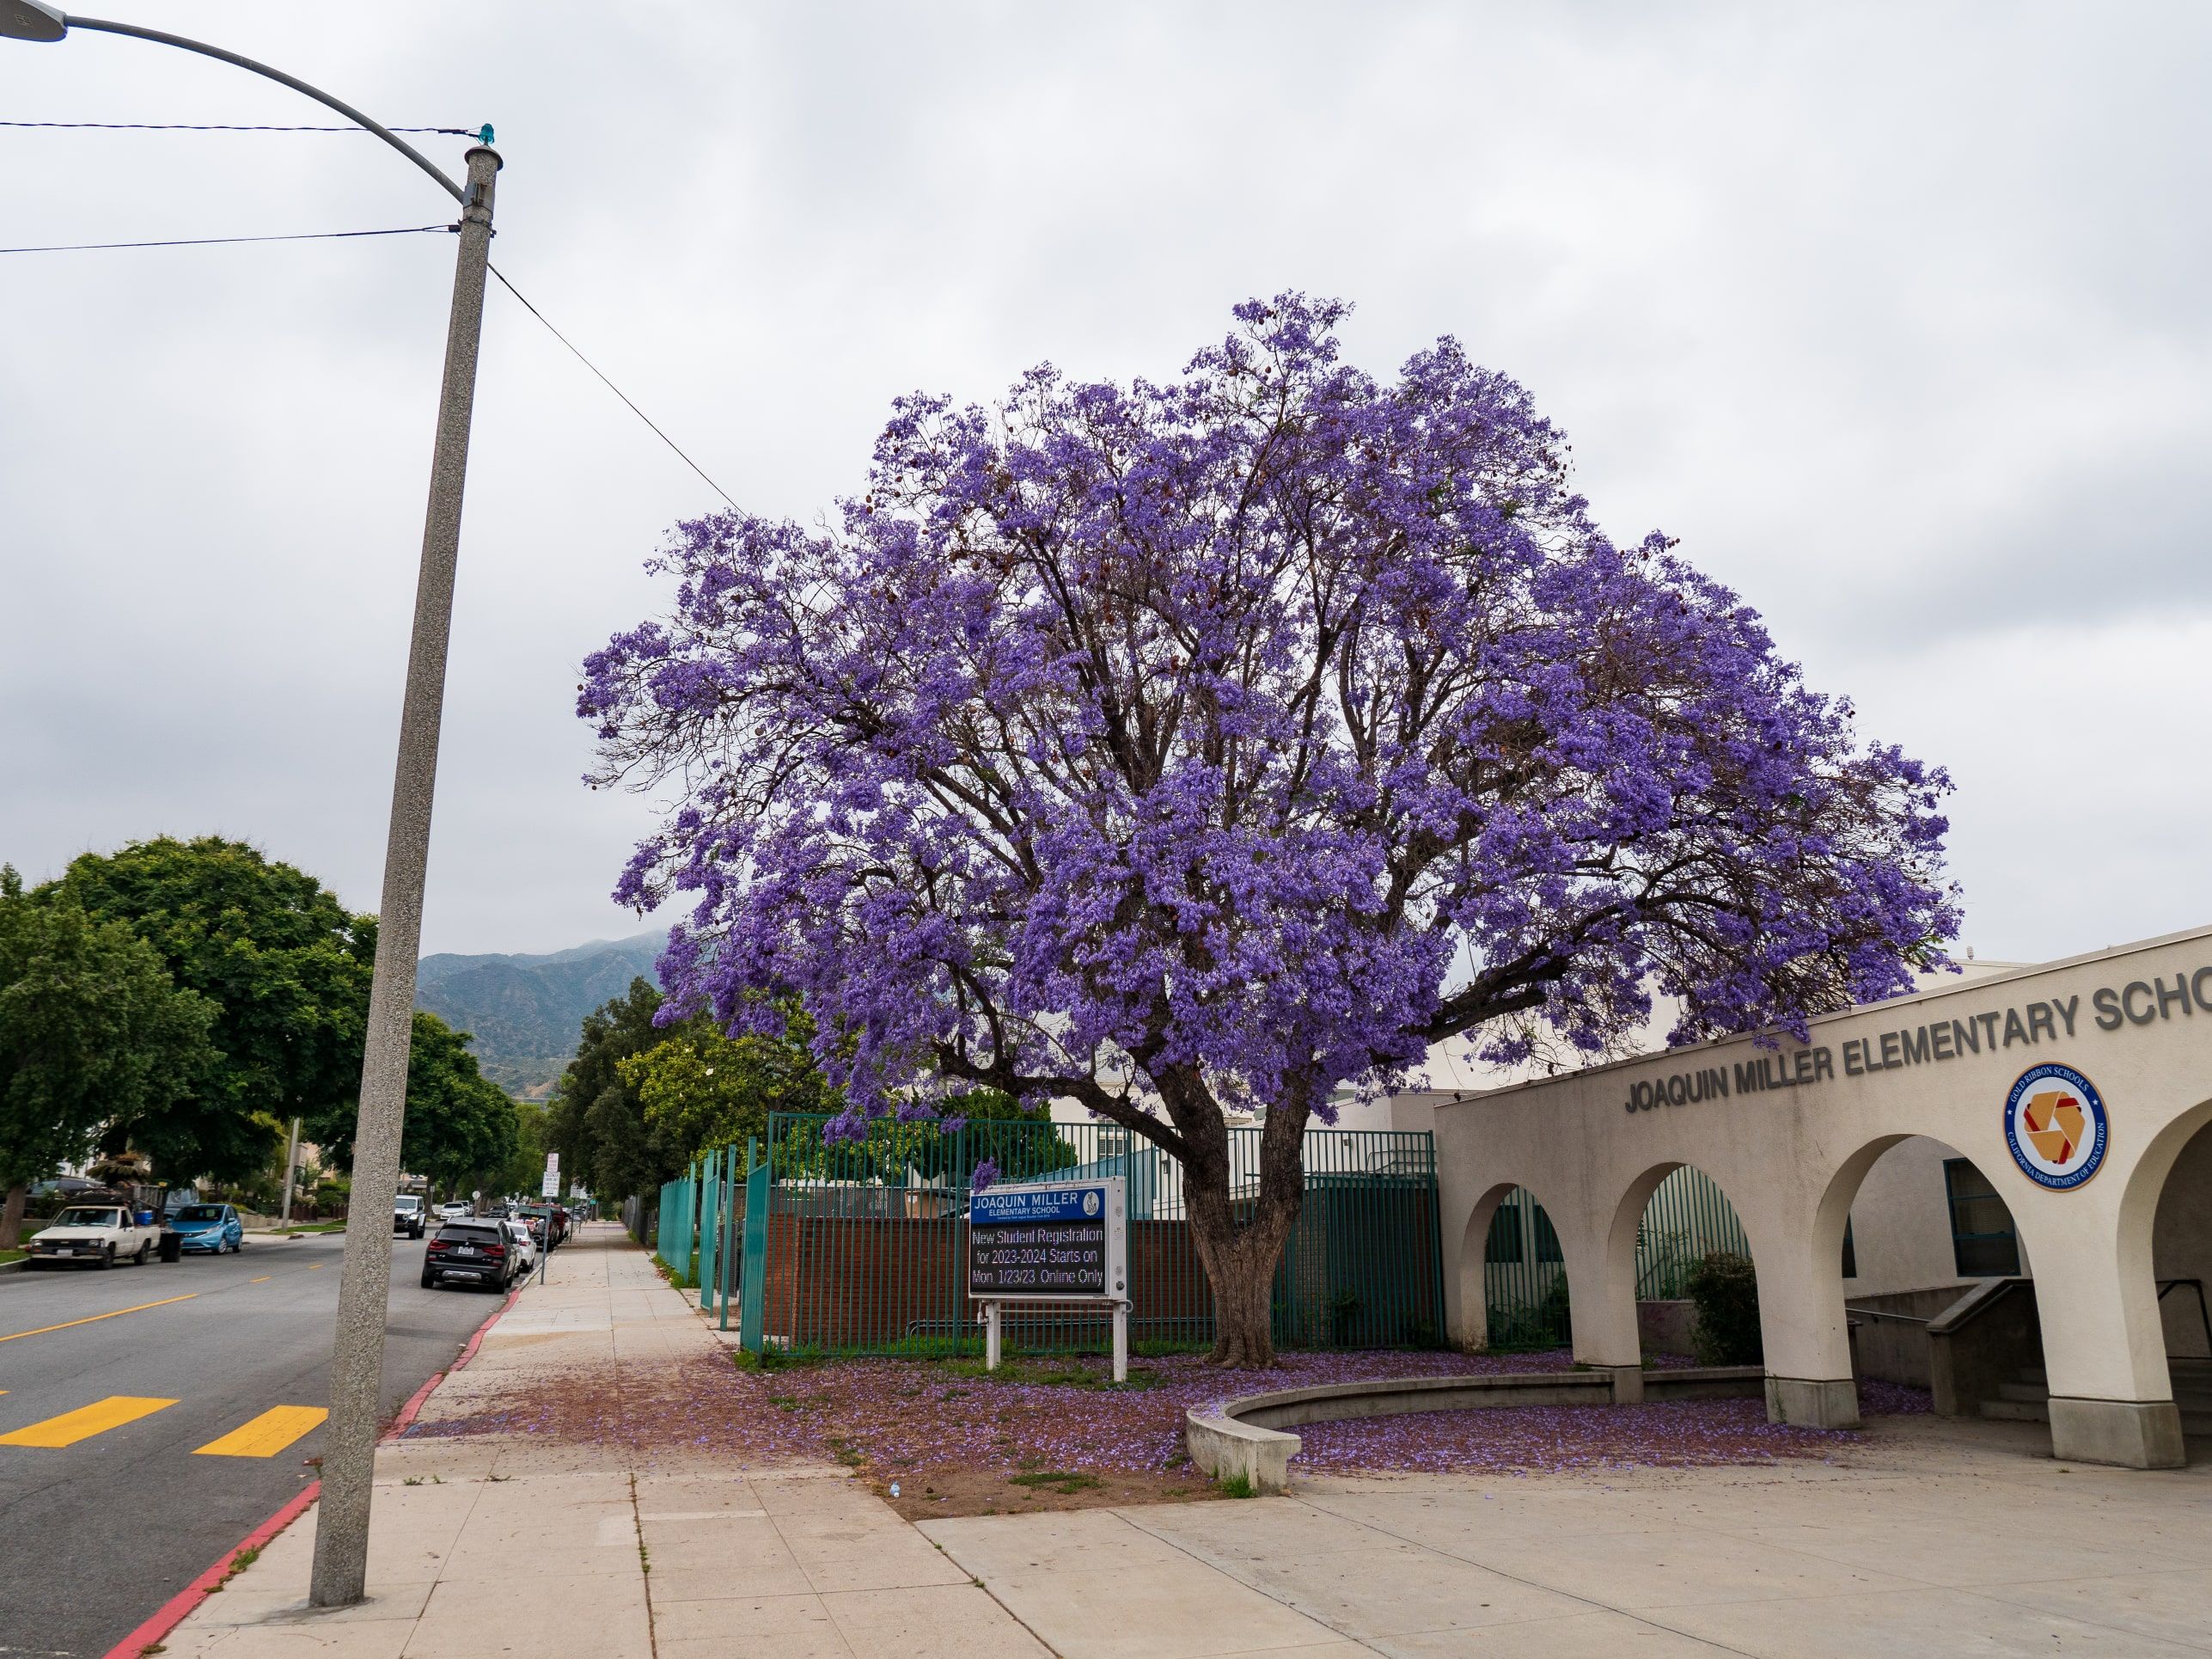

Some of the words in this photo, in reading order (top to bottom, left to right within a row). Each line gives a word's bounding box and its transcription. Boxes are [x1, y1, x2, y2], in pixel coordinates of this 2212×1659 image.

[1624, 1066, 1729, 1114] JOAQUIN
[1733, 1046, 1834, 1094] MILLER
[1842, 994, 2078, 1075] ELEMENTARY
[2011, 1080, 2026, 1103] GOLD
[2024, 1066, 2052, 1082] RIBBON
[2054, 1067, 2089, 1092] SCHOOLS
[2007, 1131, 2035, 1174] CALIFORNIA
[2034, 1173, 2080, 1187] DEPARTMENT
[2081, 1167, 2090, 1178] OF
[2088, 1122, 2105, 1168] EDUCATION
[975, 1196, 1026, 1209] JOAQUIN
[1031, 1192, 1078, 1206] MILLER
[988, 1208, 1030, 1216] ELEMENTARY
[1031, 1206, 1060, 1215] SCHOOL
[972, 1231, 995, 1245] New
[997, 1229, 1035, 1244] Student
[1037, 1227, 1103, 1246] Registration
[976, 1250, 990, 1264] for
[992, 1248, 1046, 1264] 2023-2024
[1049, 1248, 1081, 1263] Starts
[1083, 1250, 1098, 1263] on
[999, 1269, 1036, 1283] 1/23/23
[1040, 1269, 1076, 1283] Online
[1078, 1269, 1103, 1287] Only
